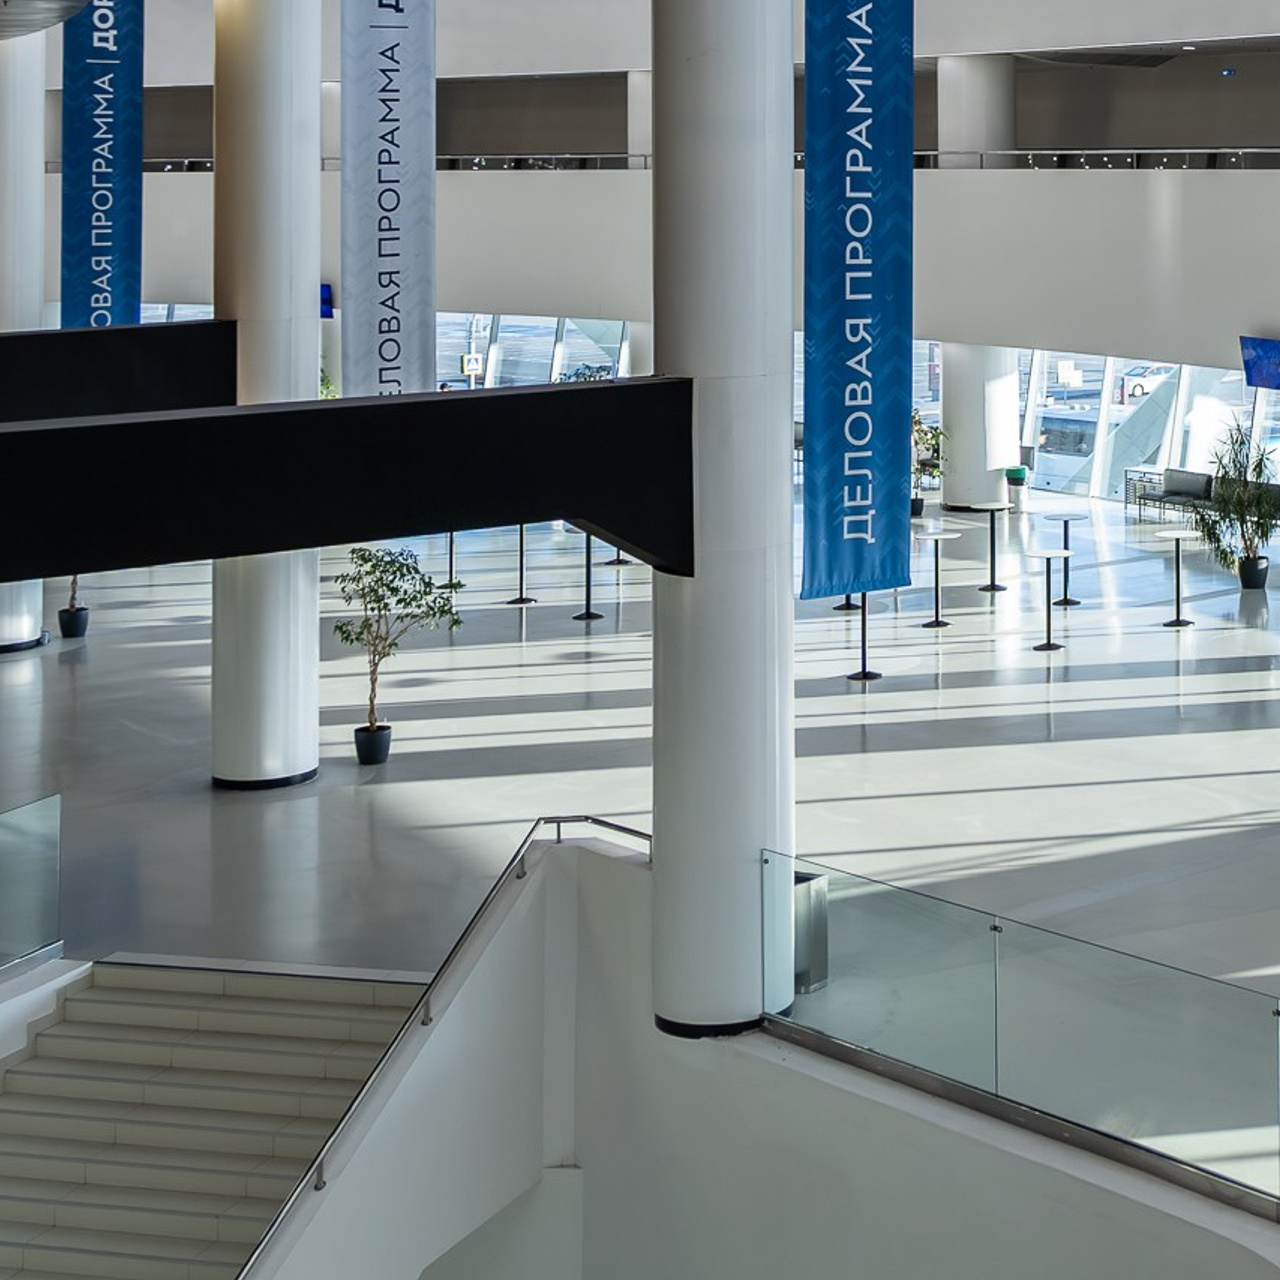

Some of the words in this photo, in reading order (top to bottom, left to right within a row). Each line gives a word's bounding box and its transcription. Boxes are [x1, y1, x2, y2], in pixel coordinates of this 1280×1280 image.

[92, 73, 114, 248] ПРОГРАММА
[377, 41, 401, 259] ПРОГРАММА
[844, 2, 873, 300] ПРОГРАММА
[843, 317, 875, 544] ДЕЛОВАЯ
